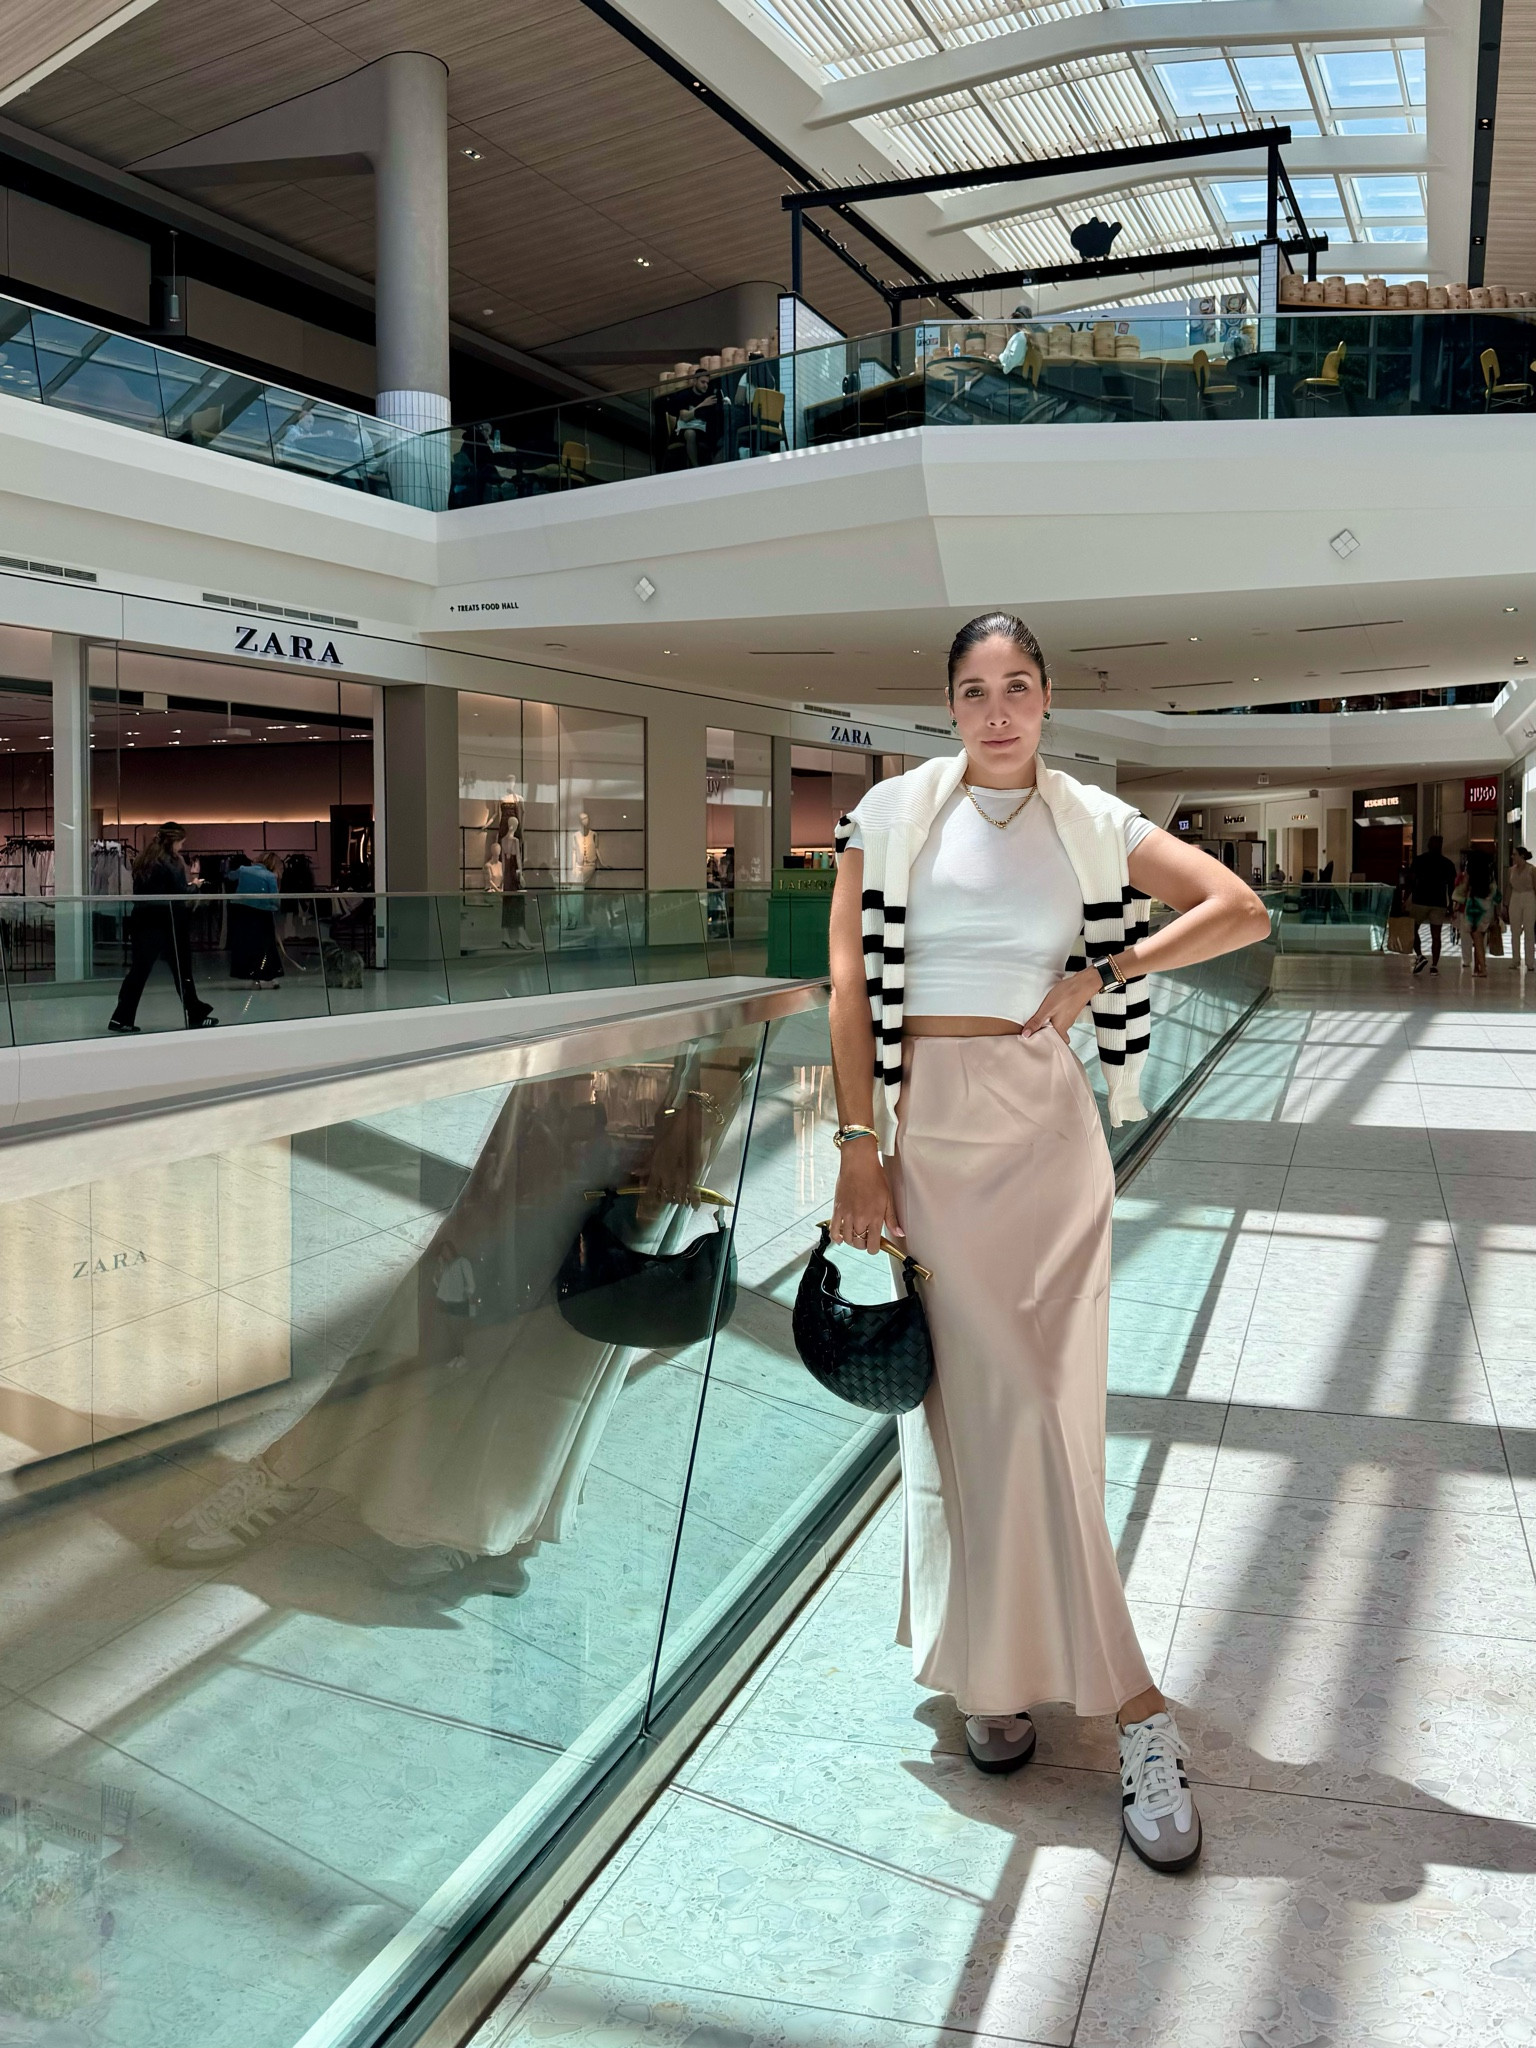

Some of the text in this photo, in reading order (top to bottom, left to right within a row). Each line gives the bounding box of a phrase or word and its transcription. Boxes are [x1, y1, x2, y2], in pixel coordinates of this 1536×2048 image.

[457, 601, 519, 612] TREATS FOOD HALL
[234, 626, 344, 665] ZARA
[830, 725, 873, 747] ZARA
[1470, 785, 1497, 802] HUGO
[72, 1250, 149, 1279] ZARA
